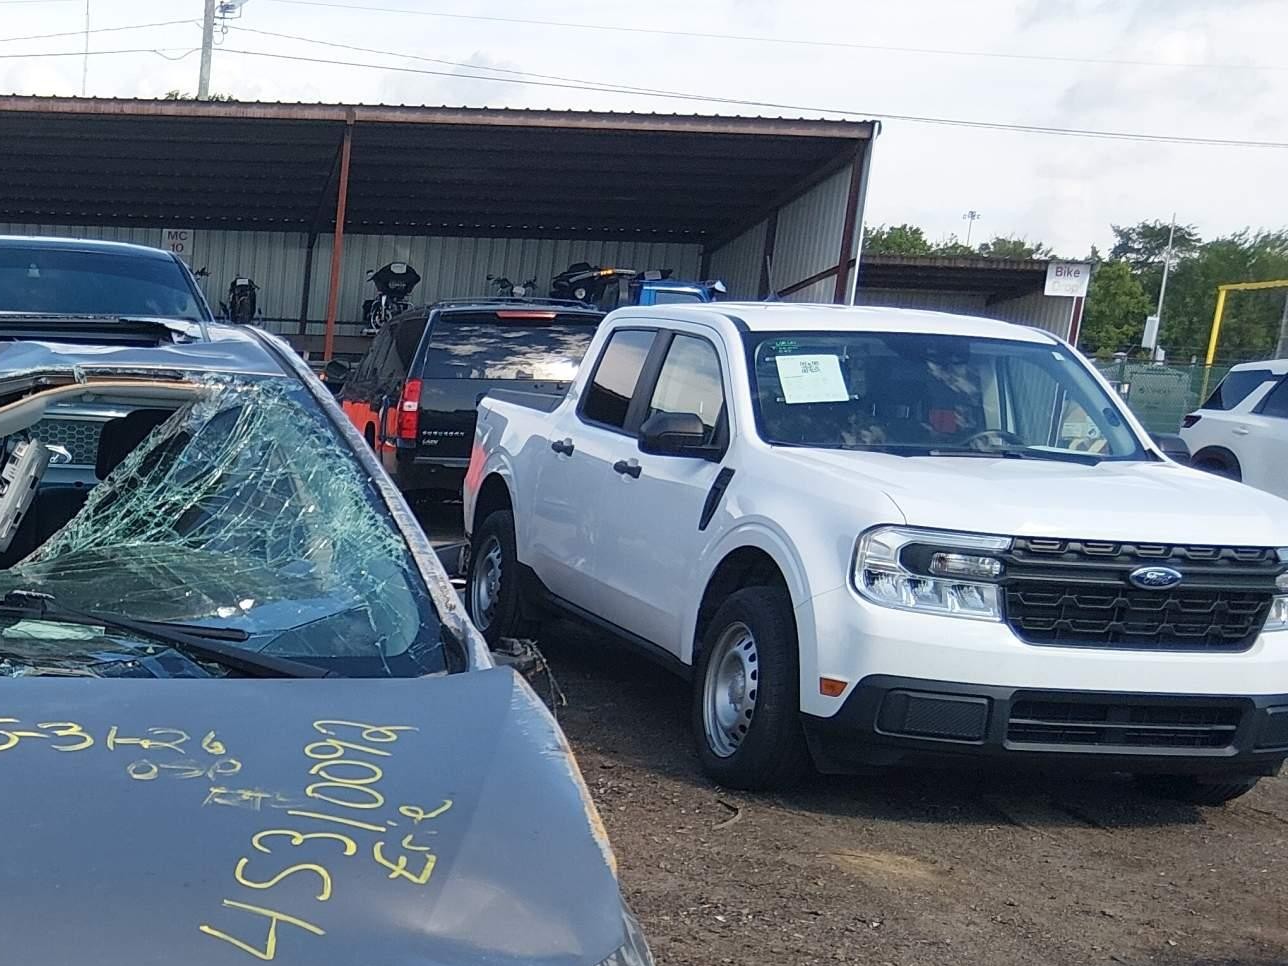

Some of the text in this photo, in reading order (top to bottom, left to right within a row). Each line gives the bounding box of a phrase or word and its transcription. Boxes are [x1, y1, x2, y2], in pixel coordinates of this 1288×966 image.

[167, 230, 188, 241] MC
[171, 242, 184, 253] 10
[1055, 265, 1081, 278] Bike
[1143, 571, 1173, 584] Ford
